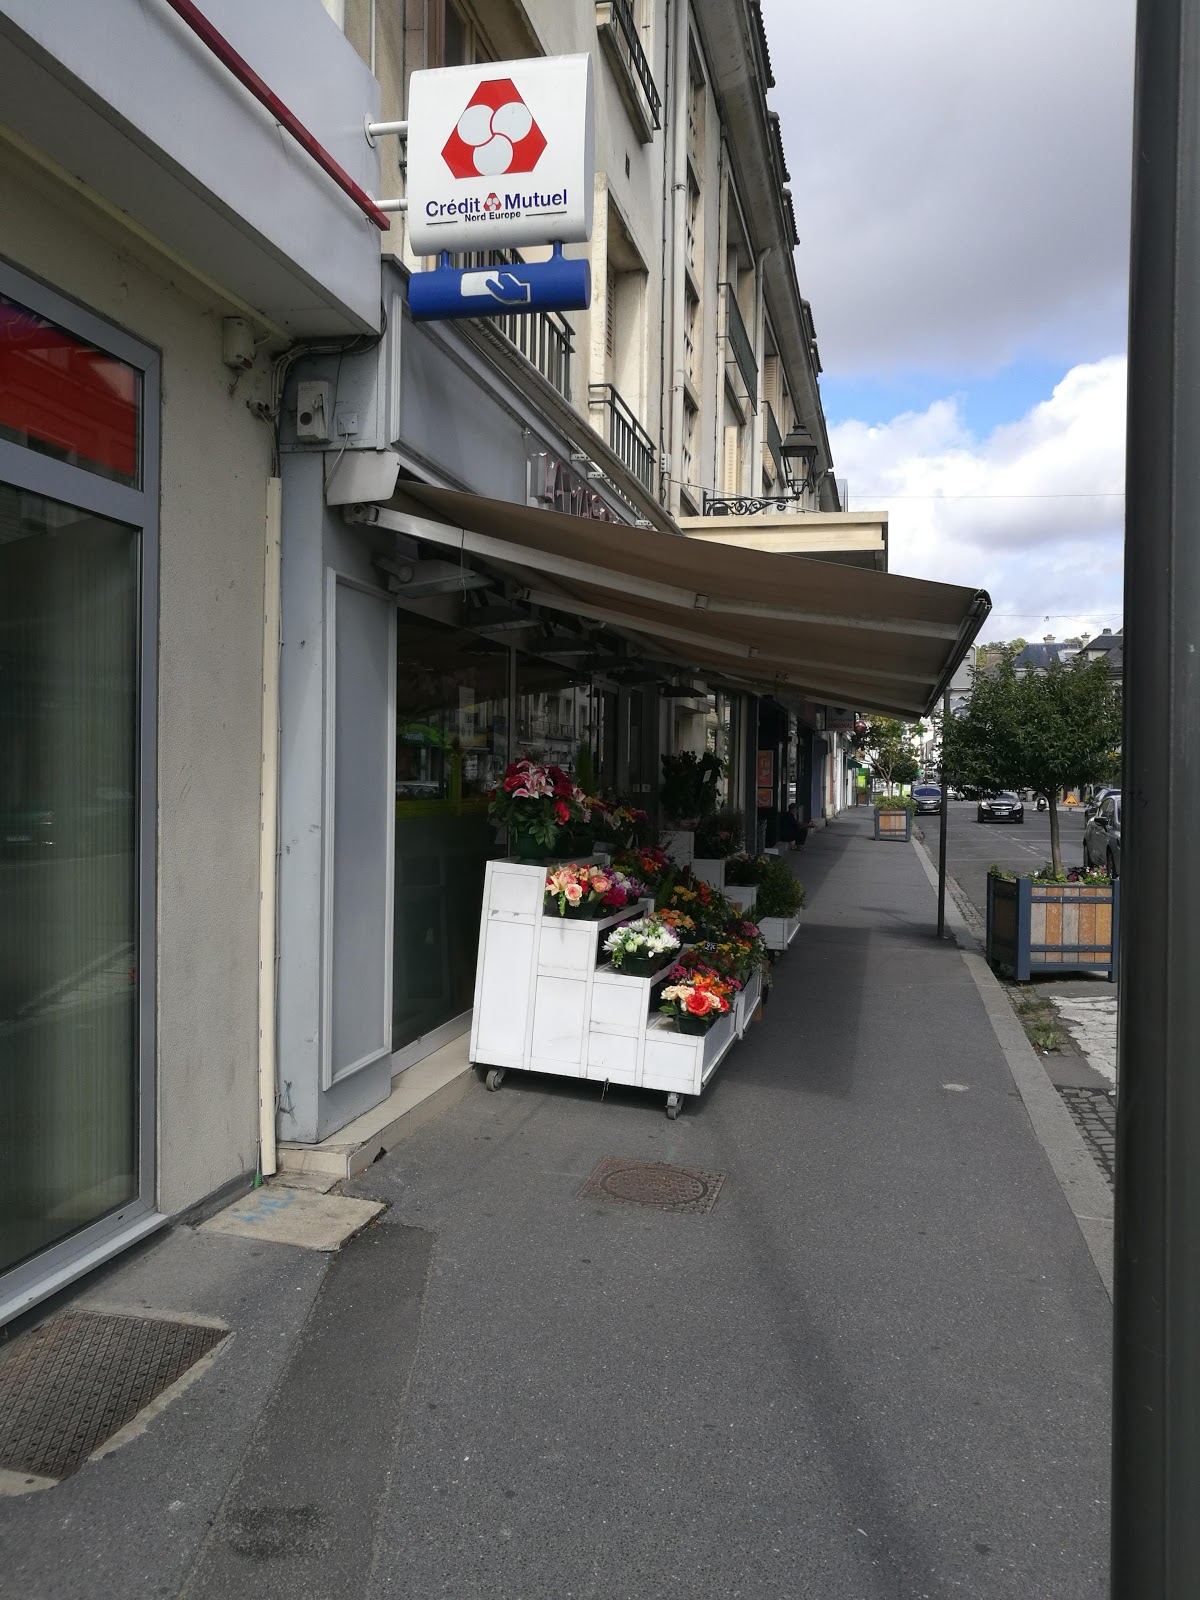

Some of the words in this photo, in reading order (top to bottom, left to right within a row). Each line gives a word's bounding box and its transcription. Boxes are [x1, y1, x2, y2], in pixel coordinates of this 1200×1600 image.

[425, 198, 481, 217] Crédit
[504, 189, 567, 210] Mutuel
[464, 212, 486, 222] Nord
[489, 210, 521, 220] Europe
